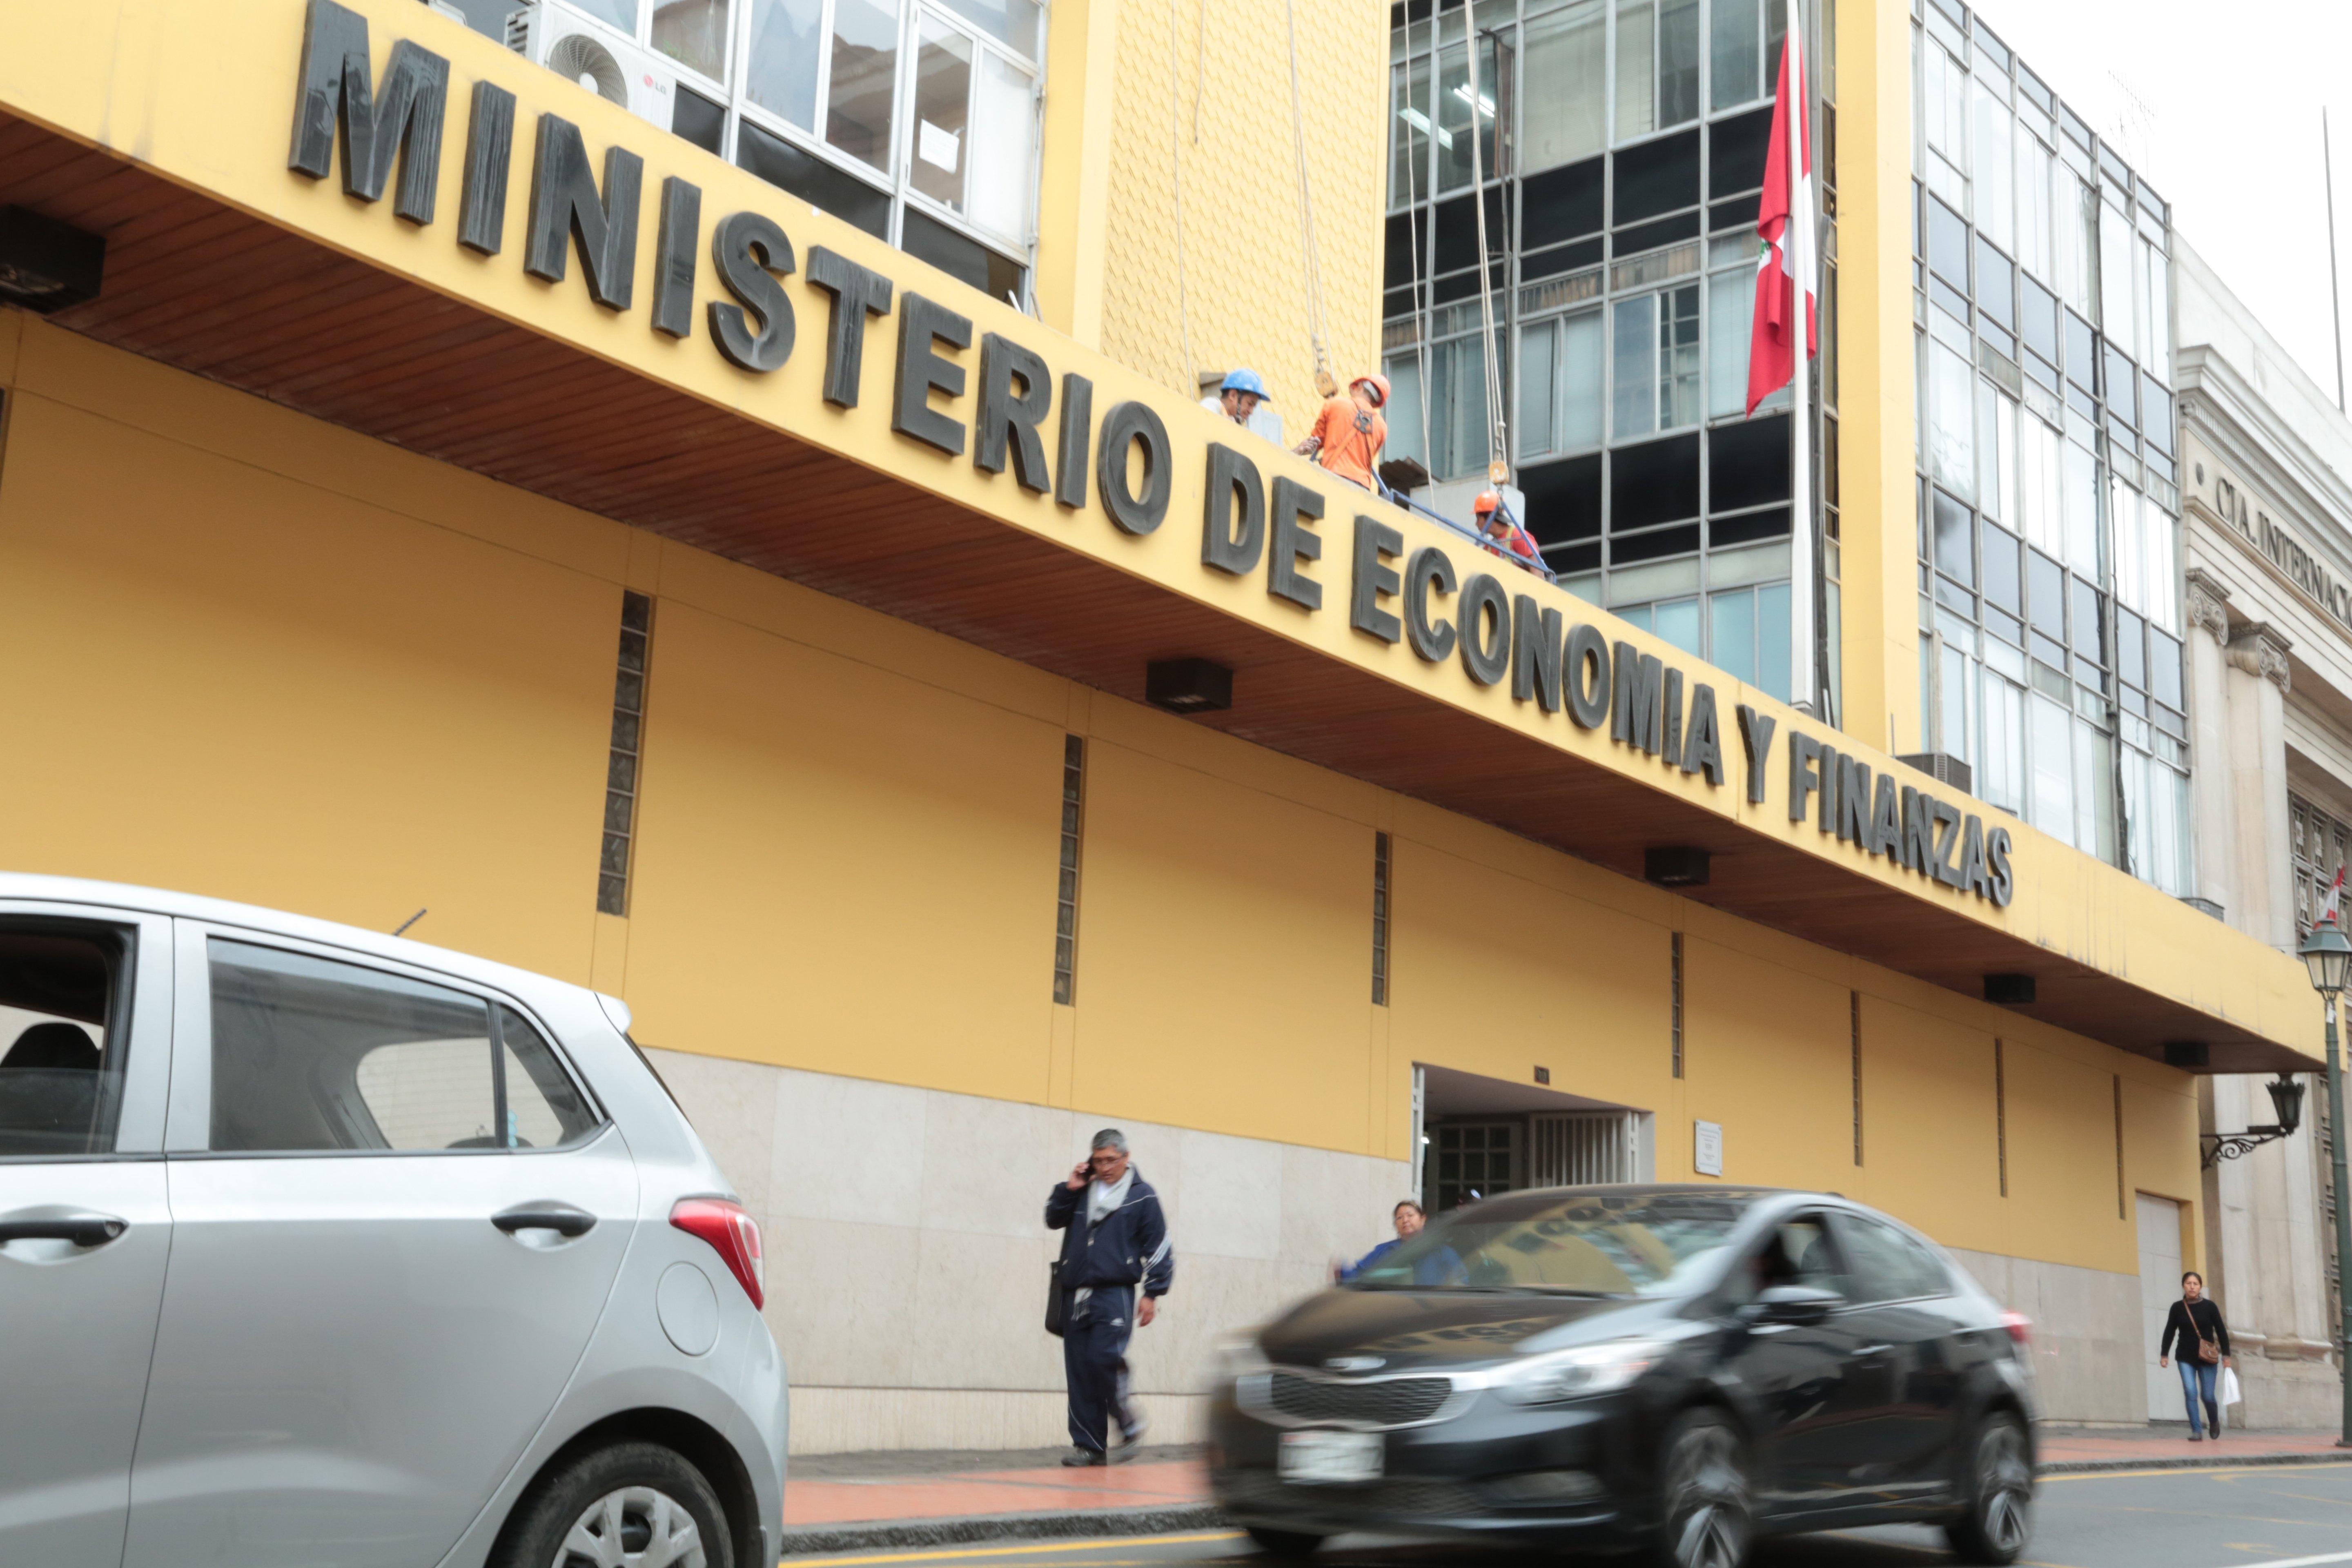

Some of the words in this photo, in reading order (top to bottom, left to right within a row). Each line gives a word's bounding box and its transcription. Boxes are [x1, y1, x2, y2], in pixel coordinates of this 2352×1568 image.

[655, 81, 666, 96] LG
[288, 0, 1172, 535] MINISTERIO
[1201, 442, 1325, 611] DE
[1350, 515, 1724, 786] ECONOMIA
[1735, 704, 1776, 804] Y
[1788, 731, 2013, 907] FINANZAS
